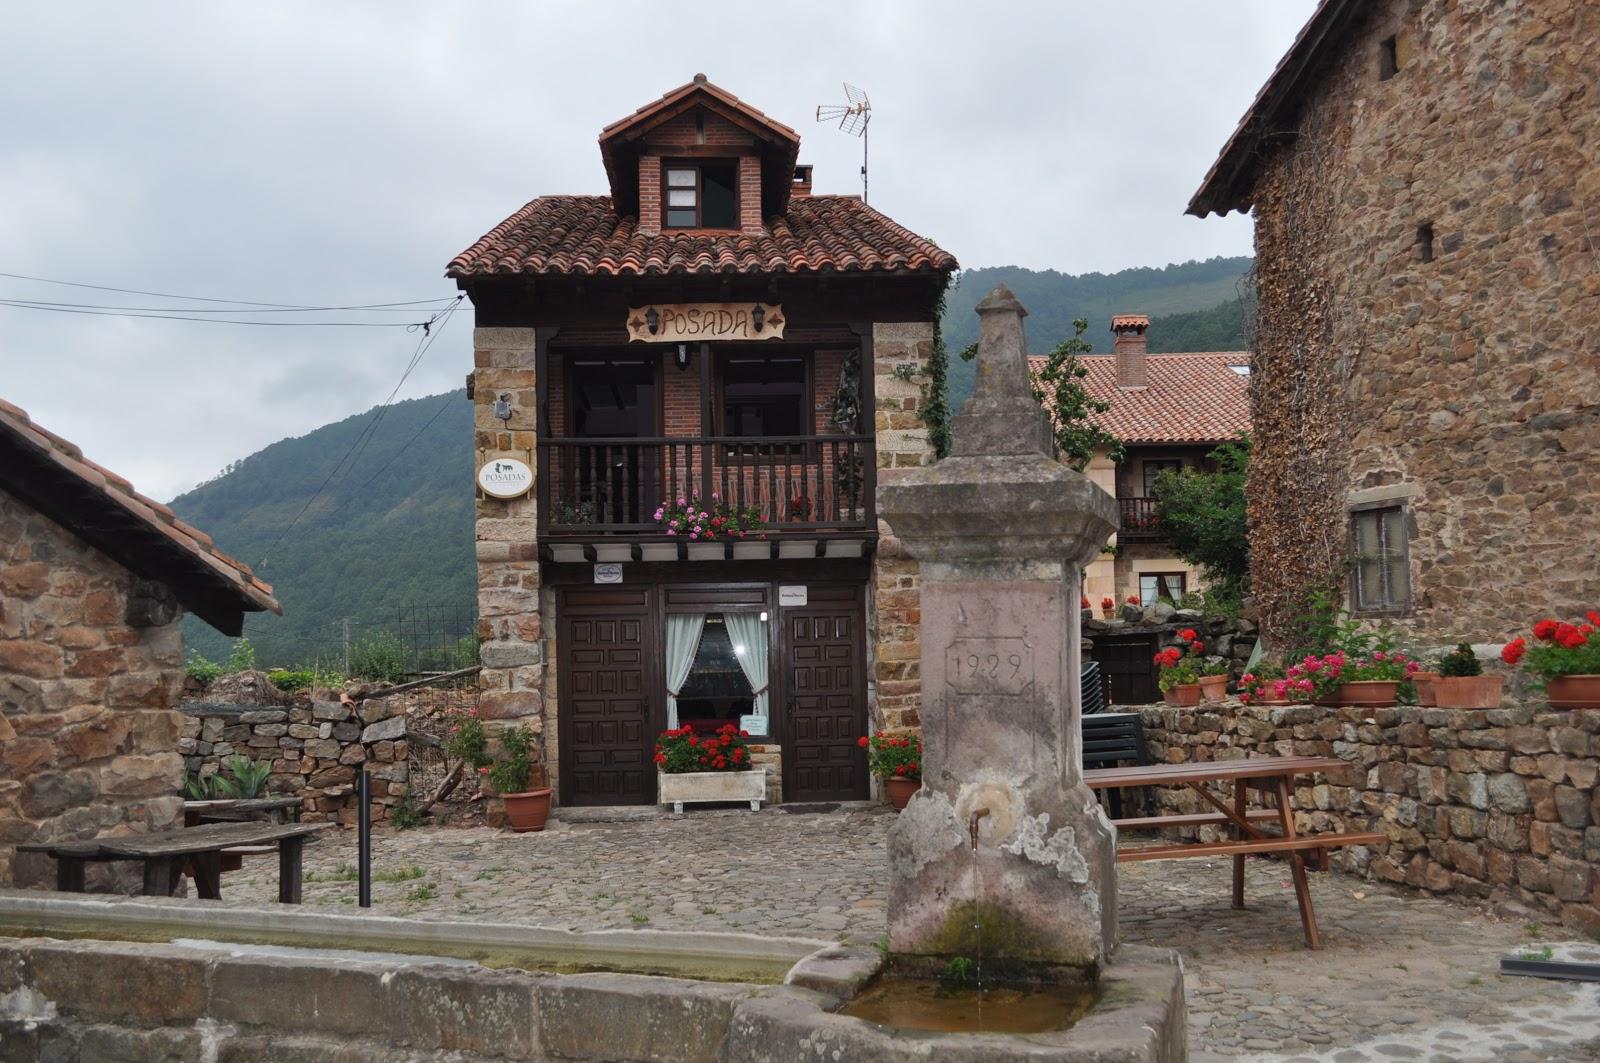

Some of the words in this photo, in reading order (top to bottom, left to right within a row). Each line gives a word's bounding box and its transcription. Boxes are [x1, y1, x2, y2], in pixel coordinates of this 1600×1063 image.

[660, 308, 748, 338] POSADA
[485, 473, 526, 481] POSADAS
[951, 654, 1021, 680] 1929
